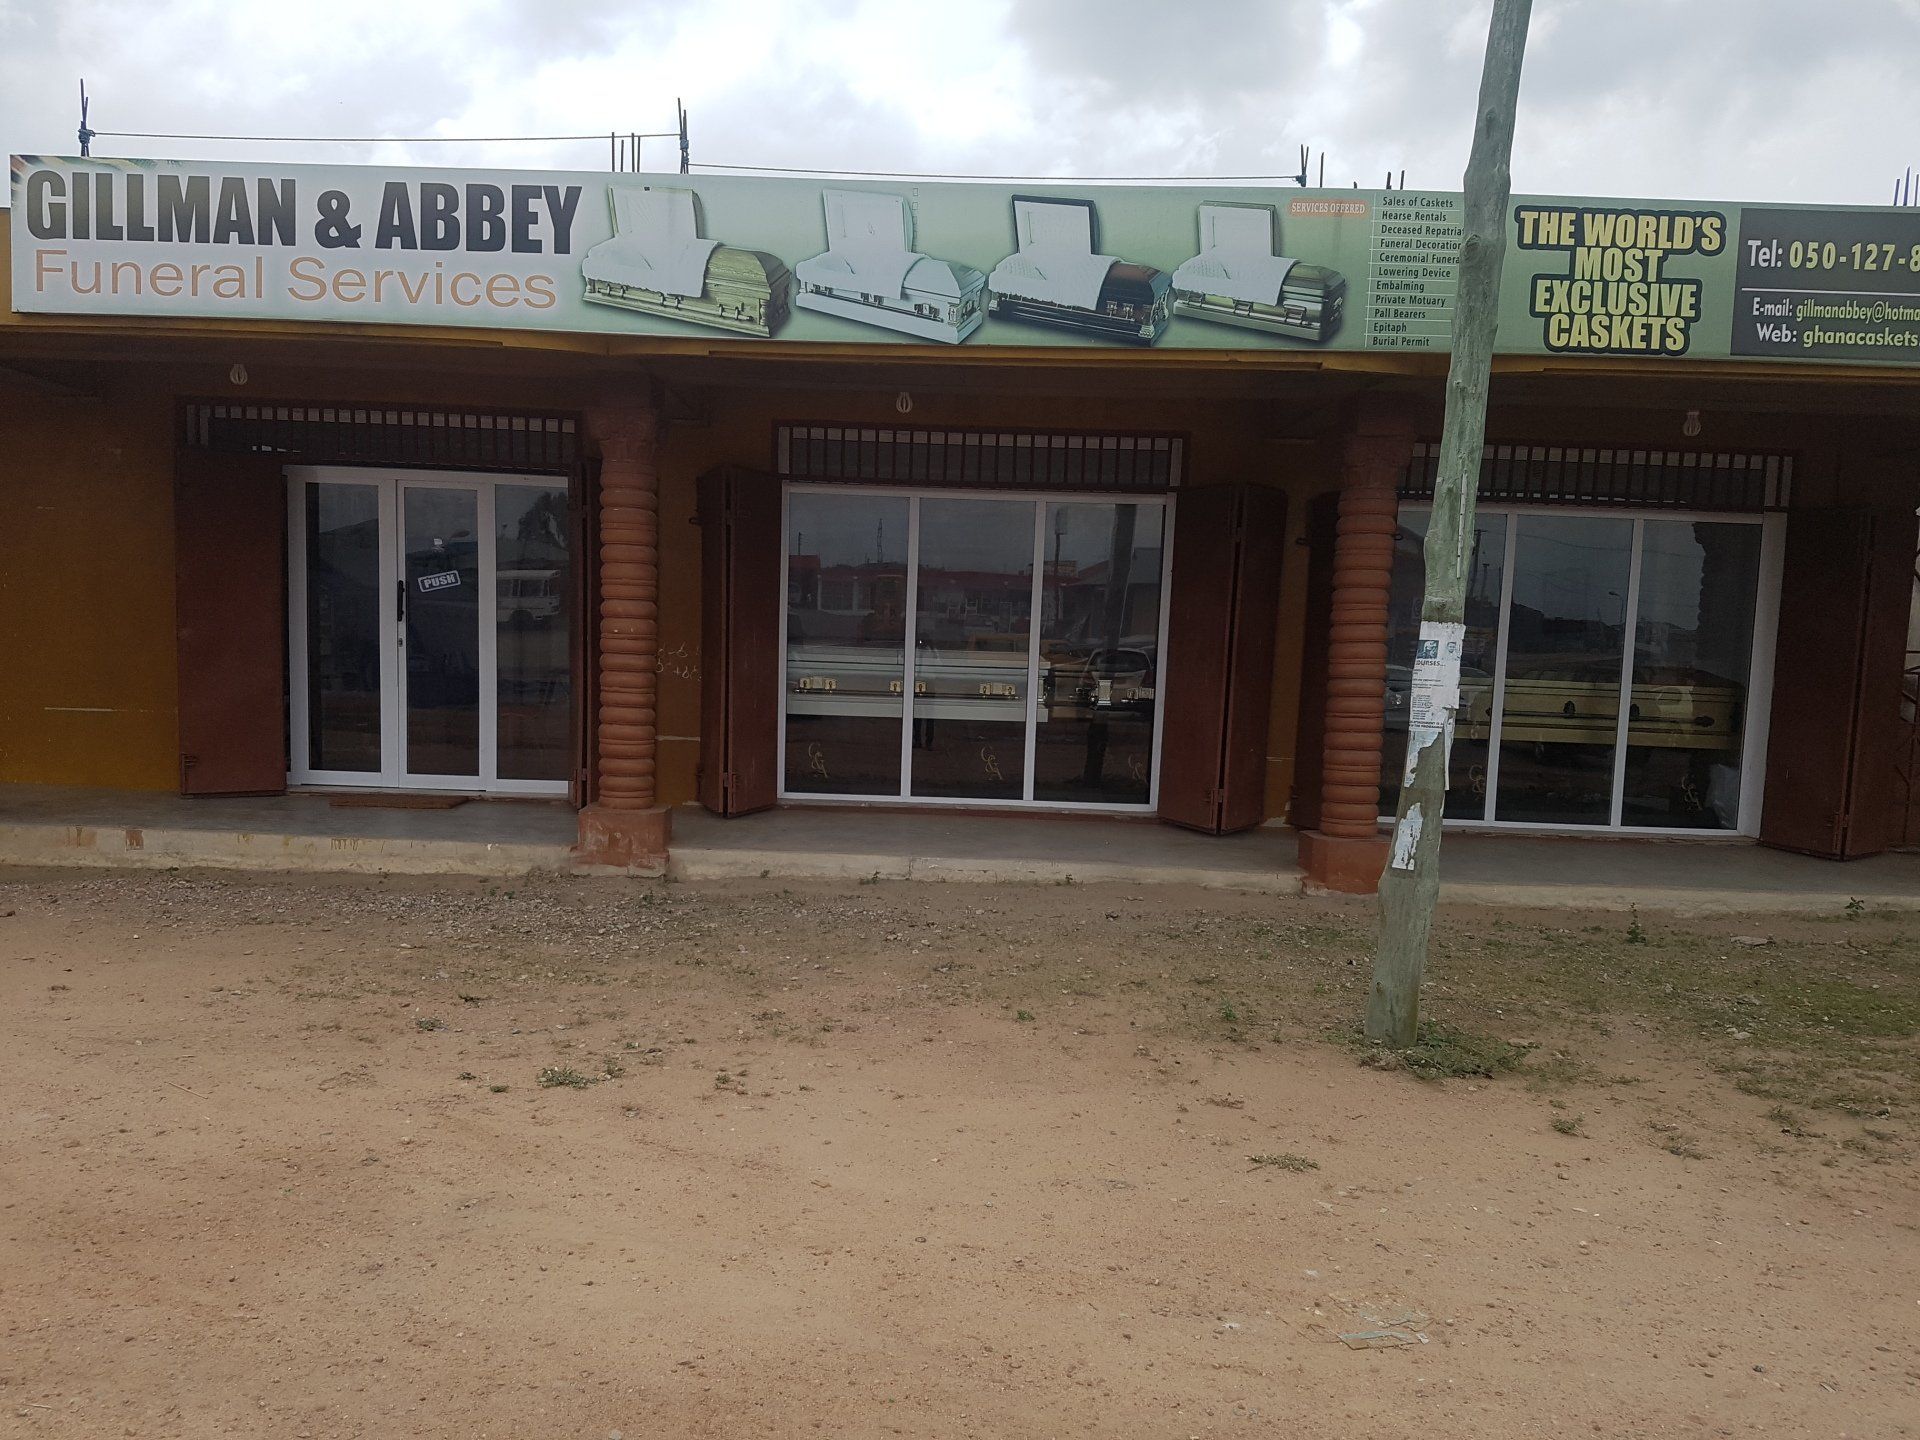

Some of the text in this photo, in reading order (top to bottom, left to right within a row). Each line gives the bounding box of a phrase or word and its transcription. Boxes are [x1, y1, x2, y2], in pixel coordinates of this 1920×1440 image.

[1291, 203, 1366, 214] SERVICES OFFERED
[1382, 197, 1453, 208] Sales of Caskets
[26, 170, 582, 255] GILLMAN & ABBEY
[1382, 210, 1447, 222] Hearse Rentals
[1381, 225, 1422, 235] Deceased
[1520, 211, 1721, 251] THE WORLD'S
[1380, 239, 1413, 249] Funeral
[1379, 252, 1459, 264] Ceremonial Funera
[1747, 239, 1920, 272] Tel: 050-127-8
[1574, 247, 1663, 282] MOST
[1378, 266, 1451, 279] Lowering Device
[35, 249, 556, 310] Funeral Services
[1376, 281, 1425, 293] Embalming
[1375, 295, 1446, 308] Private Motuary
[1535, 279, 1697, 317] EXCLUSIVE
[1752, 297, 1793, 317] E-mail:
[1374, 309, 1426, 319] Pall Bearers
[1373, 322, 1407, 333] Epitaph
[1549, 313, 1685, 350] CASKETS
[1756, 323, 1797, 343] Web:
[1372, 337, 1430, 347] Burial Permit
[424, 574, 455, 588] PUSH
